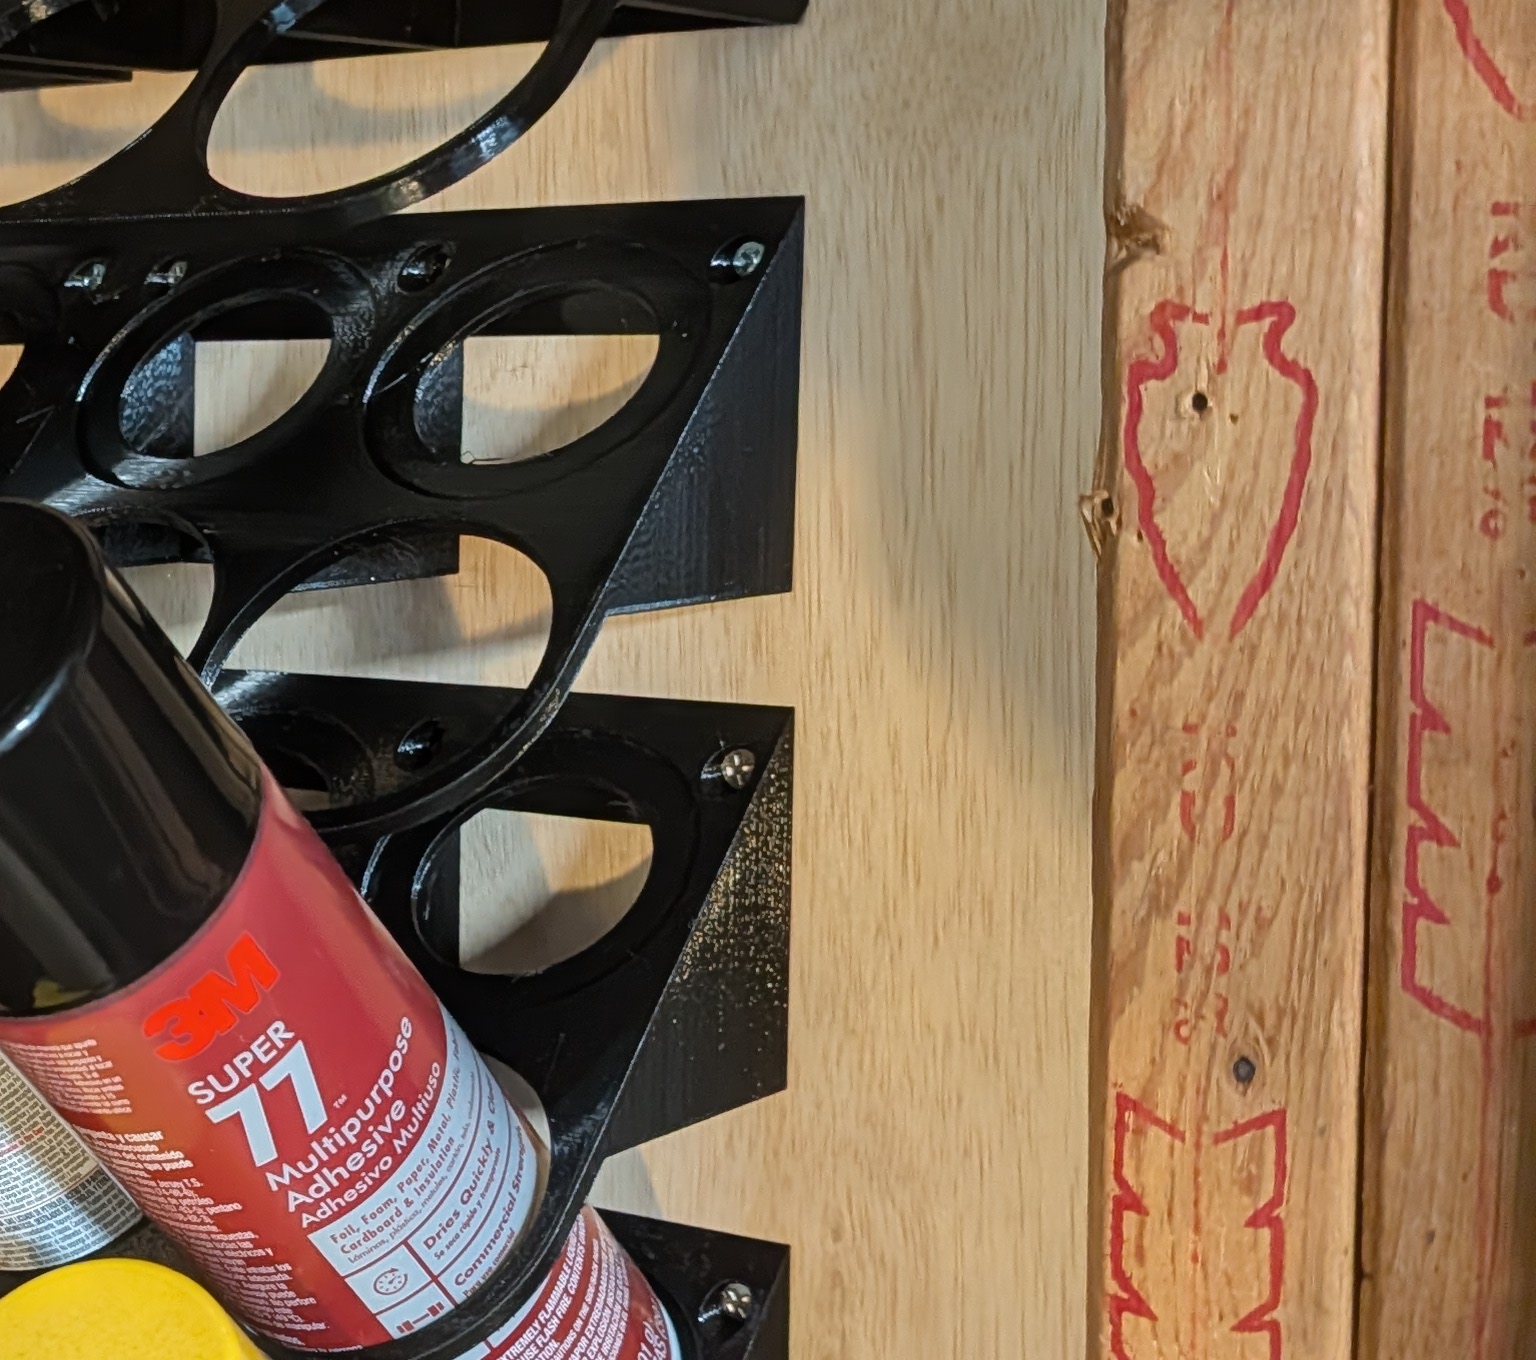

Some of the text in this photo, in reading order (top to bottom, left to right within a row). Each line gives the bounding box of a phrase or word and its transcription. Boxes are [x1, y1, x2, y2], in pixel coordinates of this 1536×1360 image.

[139, 932, 281, 1062] 3M
[186, 1018, 296, 1106] SUPER
[203, 1039, 330, 1169] 77
[262, 1013, 417, 1192] Multipurpose
[284, 1097, 409, 1214] Adhesive
[300, 1060, 443, 1229] Adhesivo Multiuso
[328, 1222, 361, 1245] Foil,
[358, 1194, 397, 1225] Foam,
[396, 1154, 431, 1195] Paper,
[426, 1111, 454, 1153] Metal,
[339, 1134, 456, 1257] Cardboard & Insulation
[422, 1209, 464, 1250] Dries
[457, 1136, 494, 1206] Quickly
[451, 1192, 518, 1288] Commercial
[534, 1313, 562, 1347] FLASH
[554, 1292, 572, 1318] FIRE.
[567, 1243, 585, 1294] CONTENTS
[537, 1267, 579, 1327] FLAMMABLE
[572, 1317, 584, 1332] ON
